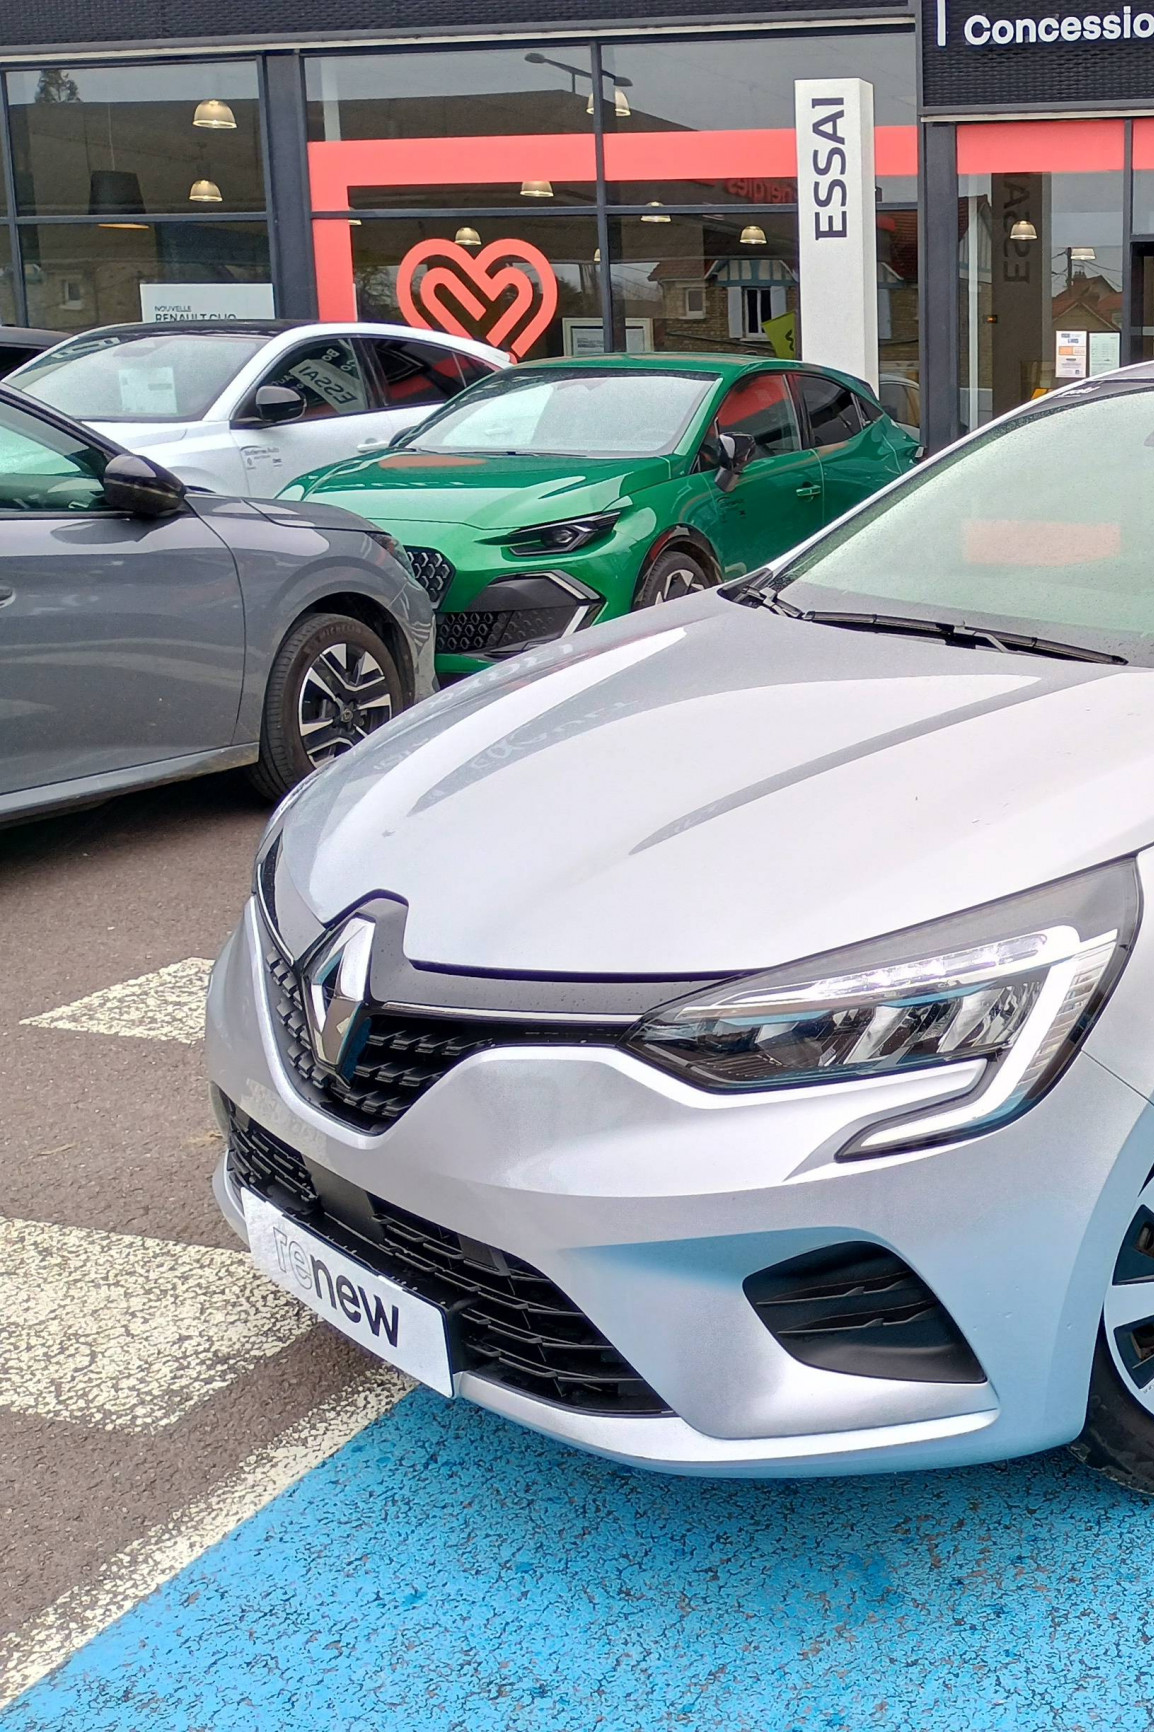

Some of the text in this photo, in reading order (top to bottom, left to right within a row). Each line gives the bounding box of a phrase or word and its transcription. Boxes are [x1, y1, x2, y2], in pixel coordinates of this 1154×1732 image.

[811, 97, 848, 241] ESSAI
[154, 305, 192, 313] NOUVELLE
[272, 1225, 400, 1349] renew
